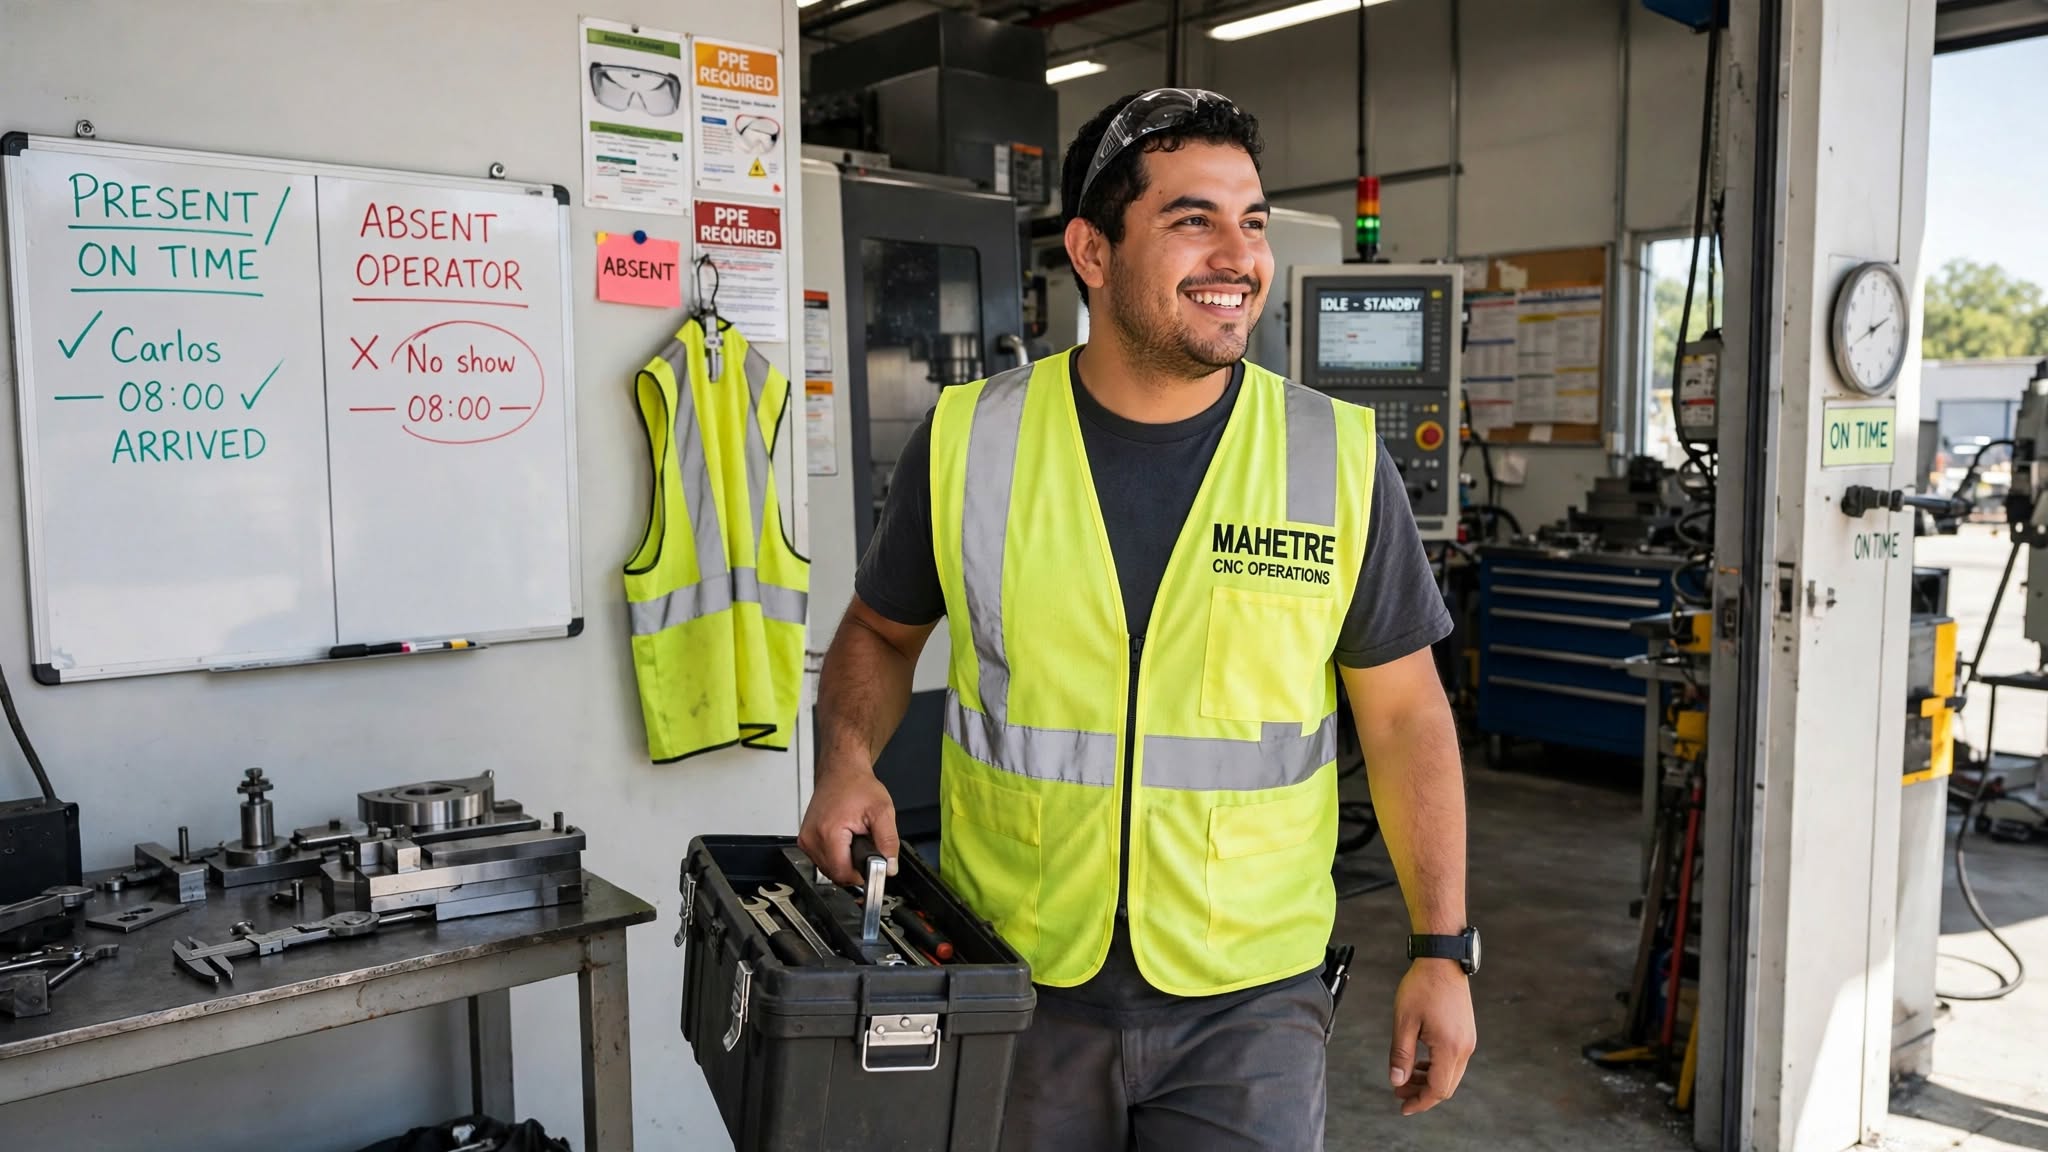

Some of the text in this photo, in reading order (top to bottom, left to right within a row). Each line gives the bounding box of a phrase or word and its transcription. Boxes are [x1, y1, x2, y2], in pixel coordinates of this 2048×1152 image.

[717, 50, 750, 72] PPE
[699, 66, 775, 92] REQUIRED
[359, 202, 498, 243] ABSENT
[714, 206, 750, 228] PPE
[700, 225, 777, 247] REQUIRED
[77, 241, 260, 282] ON TIME
[355, 252, 523, 291] OPERATOR
[603, 256, 676, 281] ABSENT
[1320, 297, 1349, 311] IDLE
[1363, 297, 1421, 311] STANDBY
[110, 326, 222, 364] Carlos
[406, 343, 444, 374] No
[456, 347, 516, 374] show
[117, 380, 225, 413] 08:00
[407, 394, 491, 423] 08:00
[111, 427, 268, 464] ARRIVED
[1830, 421, 1889, 450] ON TIME
[1212, 523, 1336, 565] MAHETRE
[1854, 532, 1900, 560] ON TIME
[1212, 558, 1331, 585] CNC OPERATIONS
